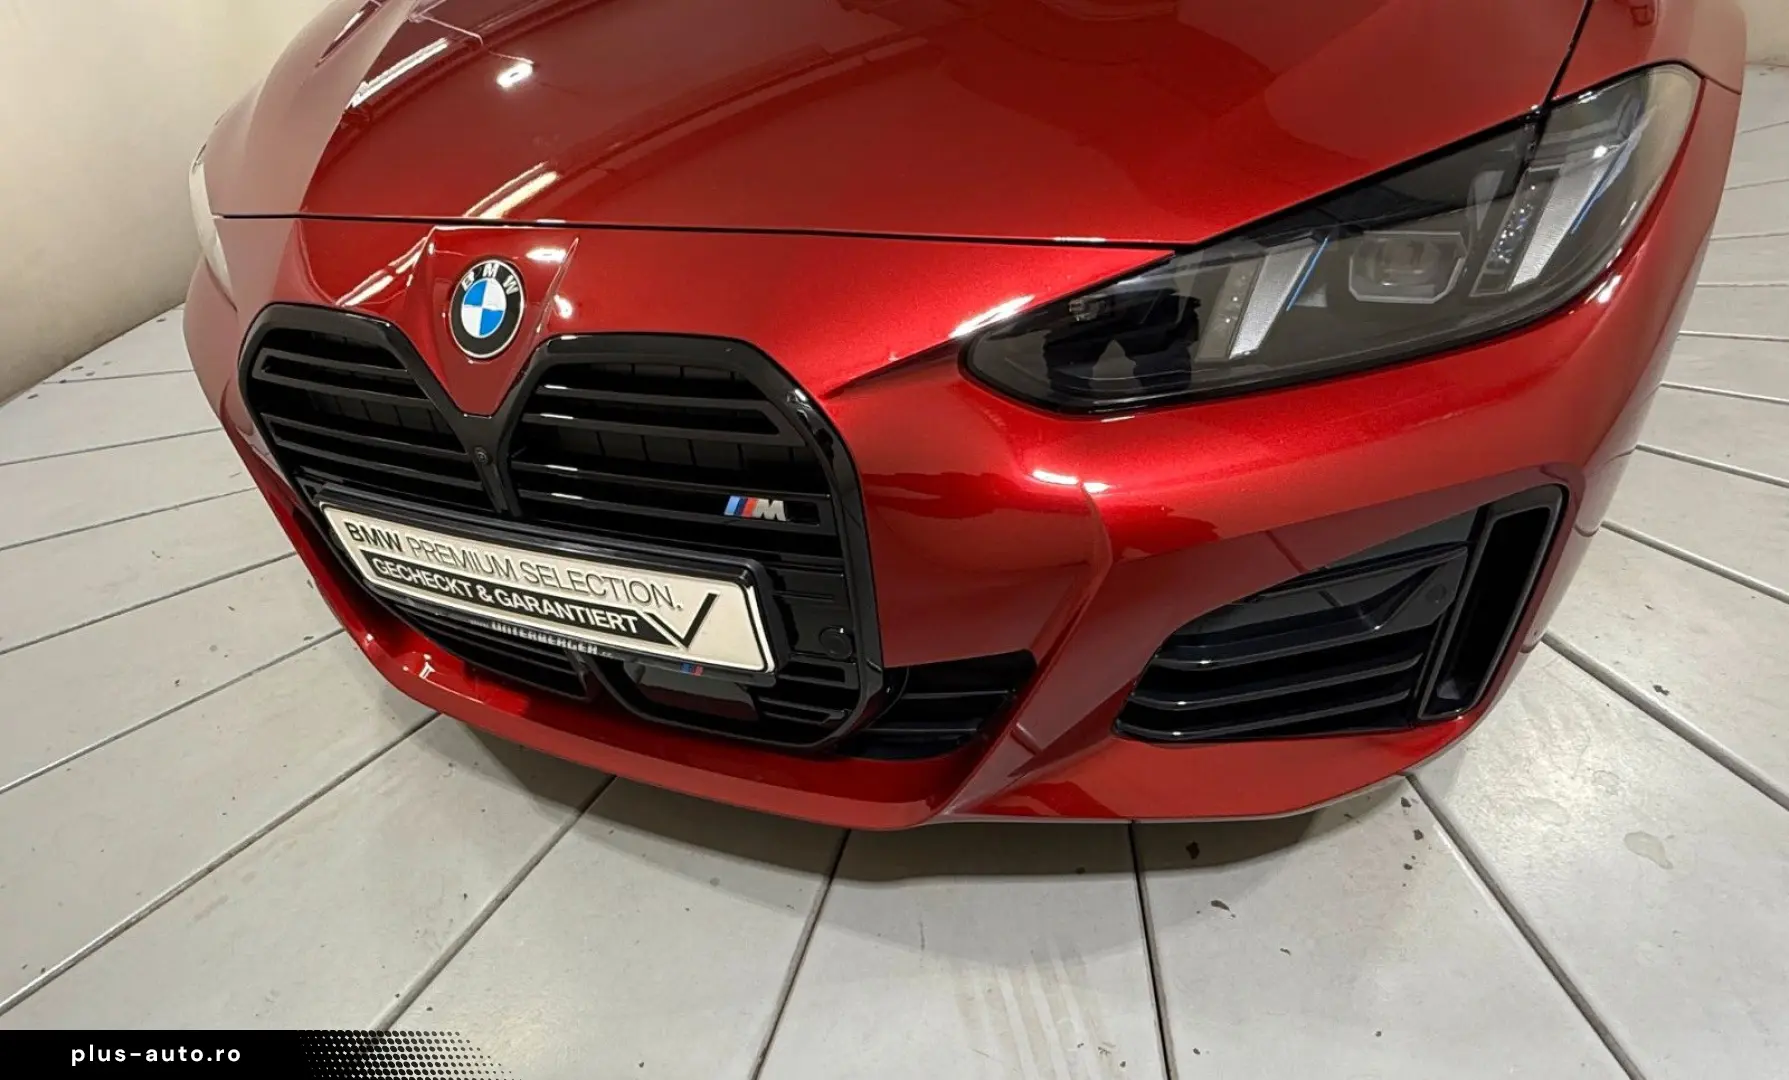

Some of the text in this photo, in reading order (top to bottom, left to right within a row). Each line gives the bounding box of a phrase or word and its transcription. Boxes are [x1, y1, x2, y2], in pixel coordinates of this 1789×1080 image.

[461, 263, 519, 295] BMW
[752, 498, 786, 521] M
[344, 521, 684, 610] BMW PREMIUM SELECTION.
[372, 557, 638, 634] GECHECKT & GARANTIERT
